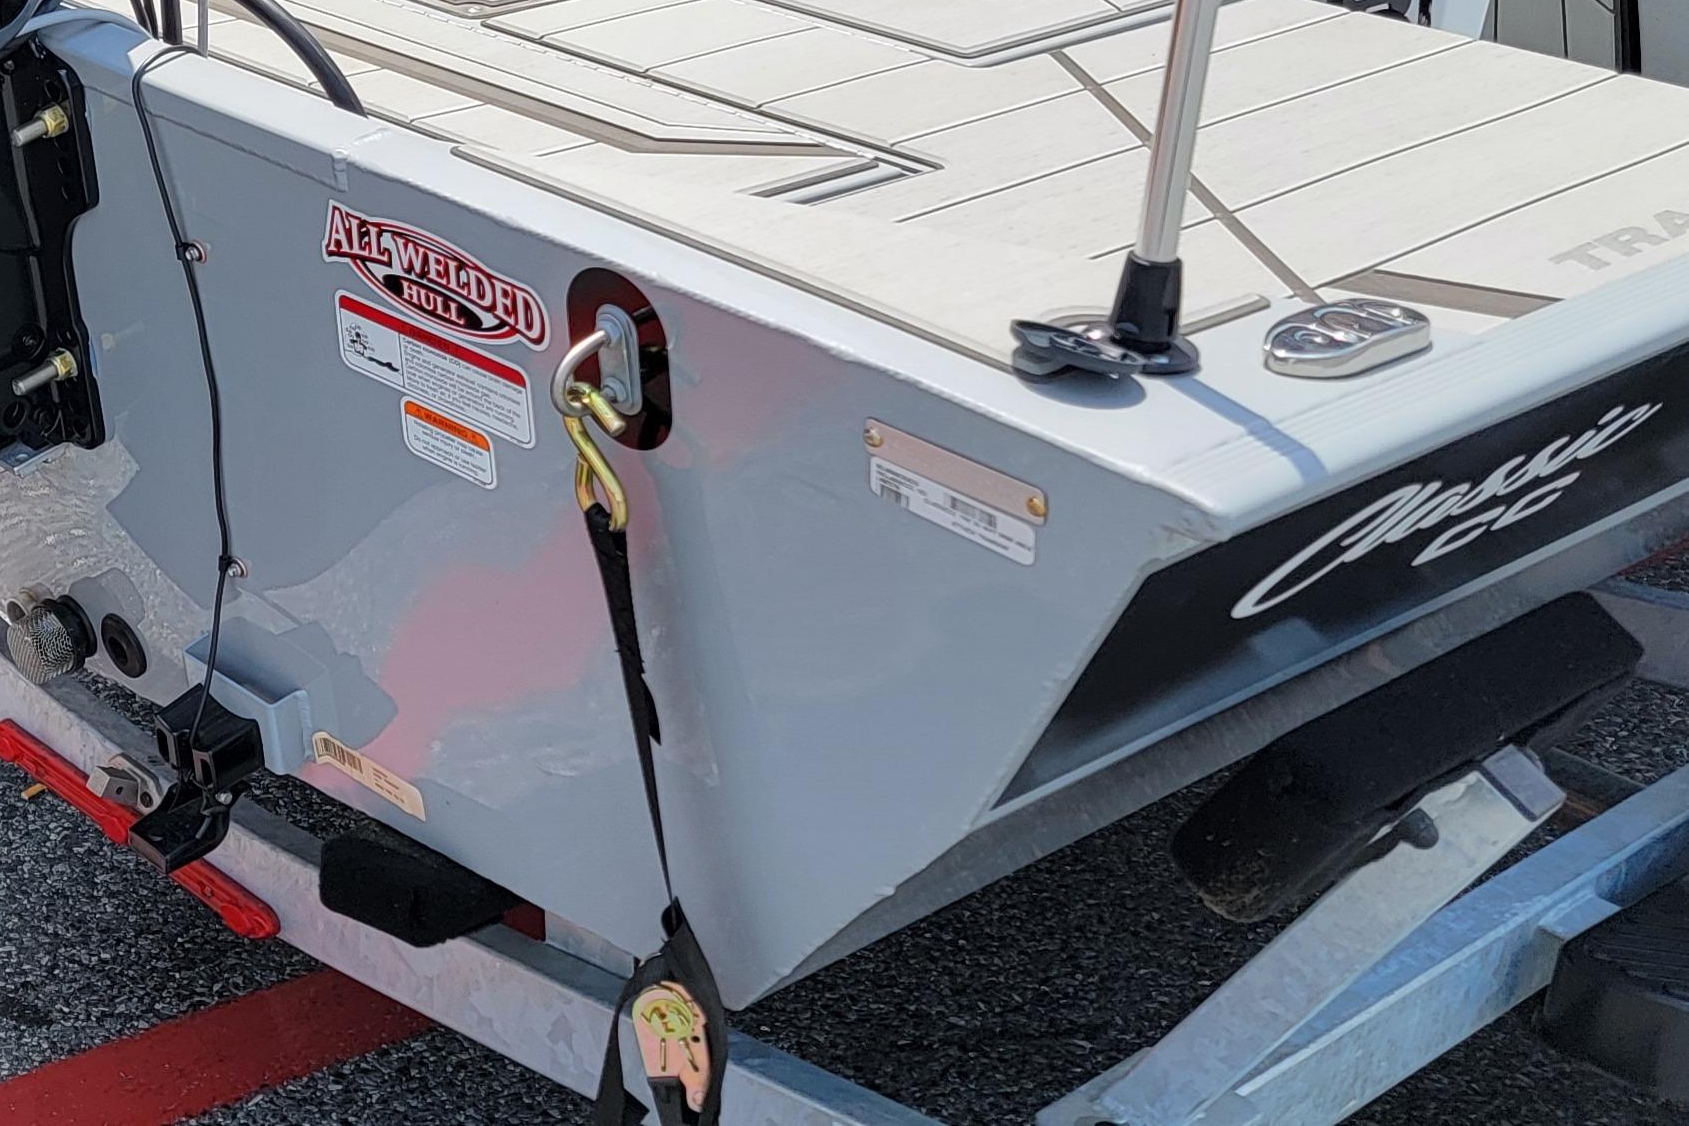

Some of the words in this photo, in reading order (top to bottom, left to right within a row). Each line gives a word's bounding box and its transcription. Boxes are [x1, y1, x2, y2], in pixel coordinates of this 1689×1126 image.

[327, 205, 392, 267] ALL
[394, 234, 545, 344] WELDED
[401, 279, 465, 325] HULL
[423, 410, 470, 440] WARNING
[1412, 471, 1582, 567] CC
